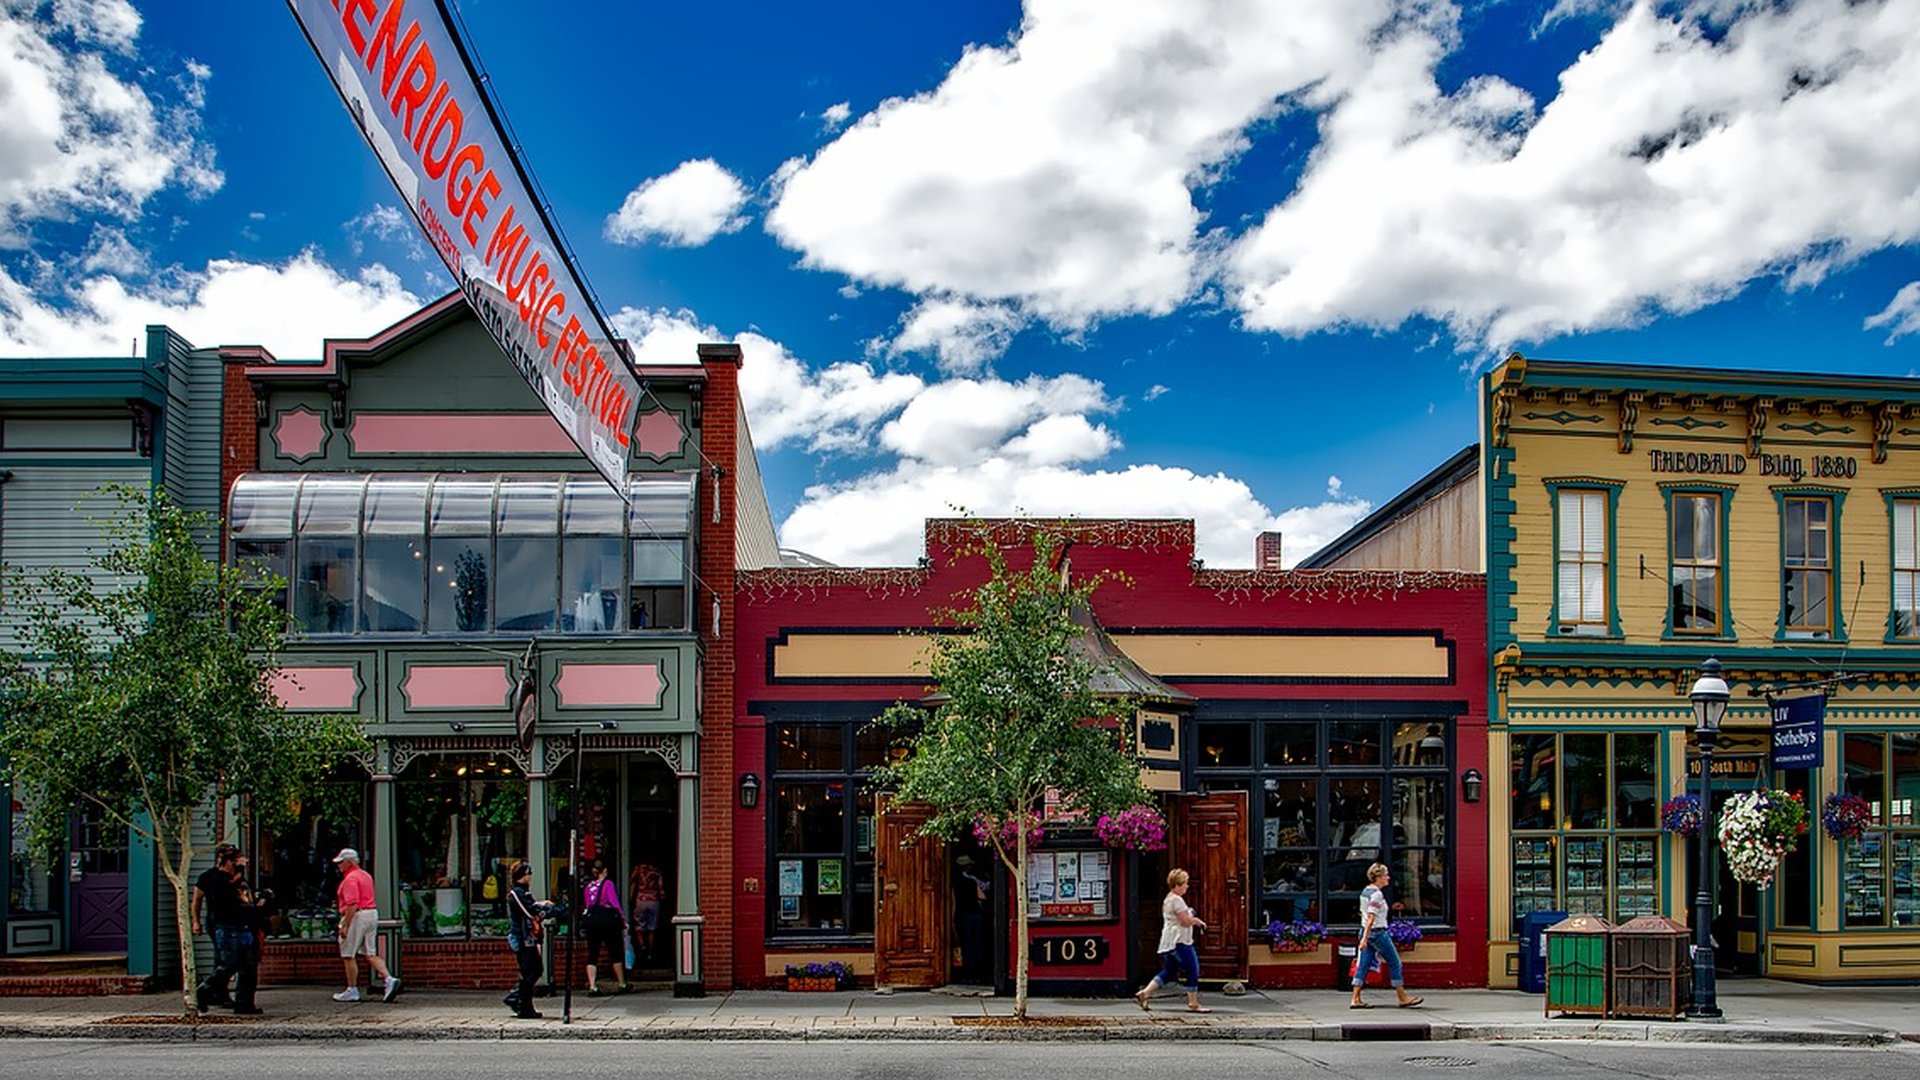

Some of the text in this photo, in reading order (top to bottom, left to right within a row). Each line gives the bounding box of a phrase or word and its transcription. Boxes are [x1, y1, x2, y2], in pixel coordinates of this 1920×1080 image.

[329, 0, 631, 448] ENRIDGE MUSIC FESTIVAL
[1648, 450, 1858, 482] THEOBALD Bldg. 1880
[1774, 707, 1789, 721] LIV
[1774, 728, 1816, 747] Sotheby's
[1710, 761, 1733, 774] South
[1735, 760, 1757, 774] Main
[1043, 939, 1097, 962] 103
